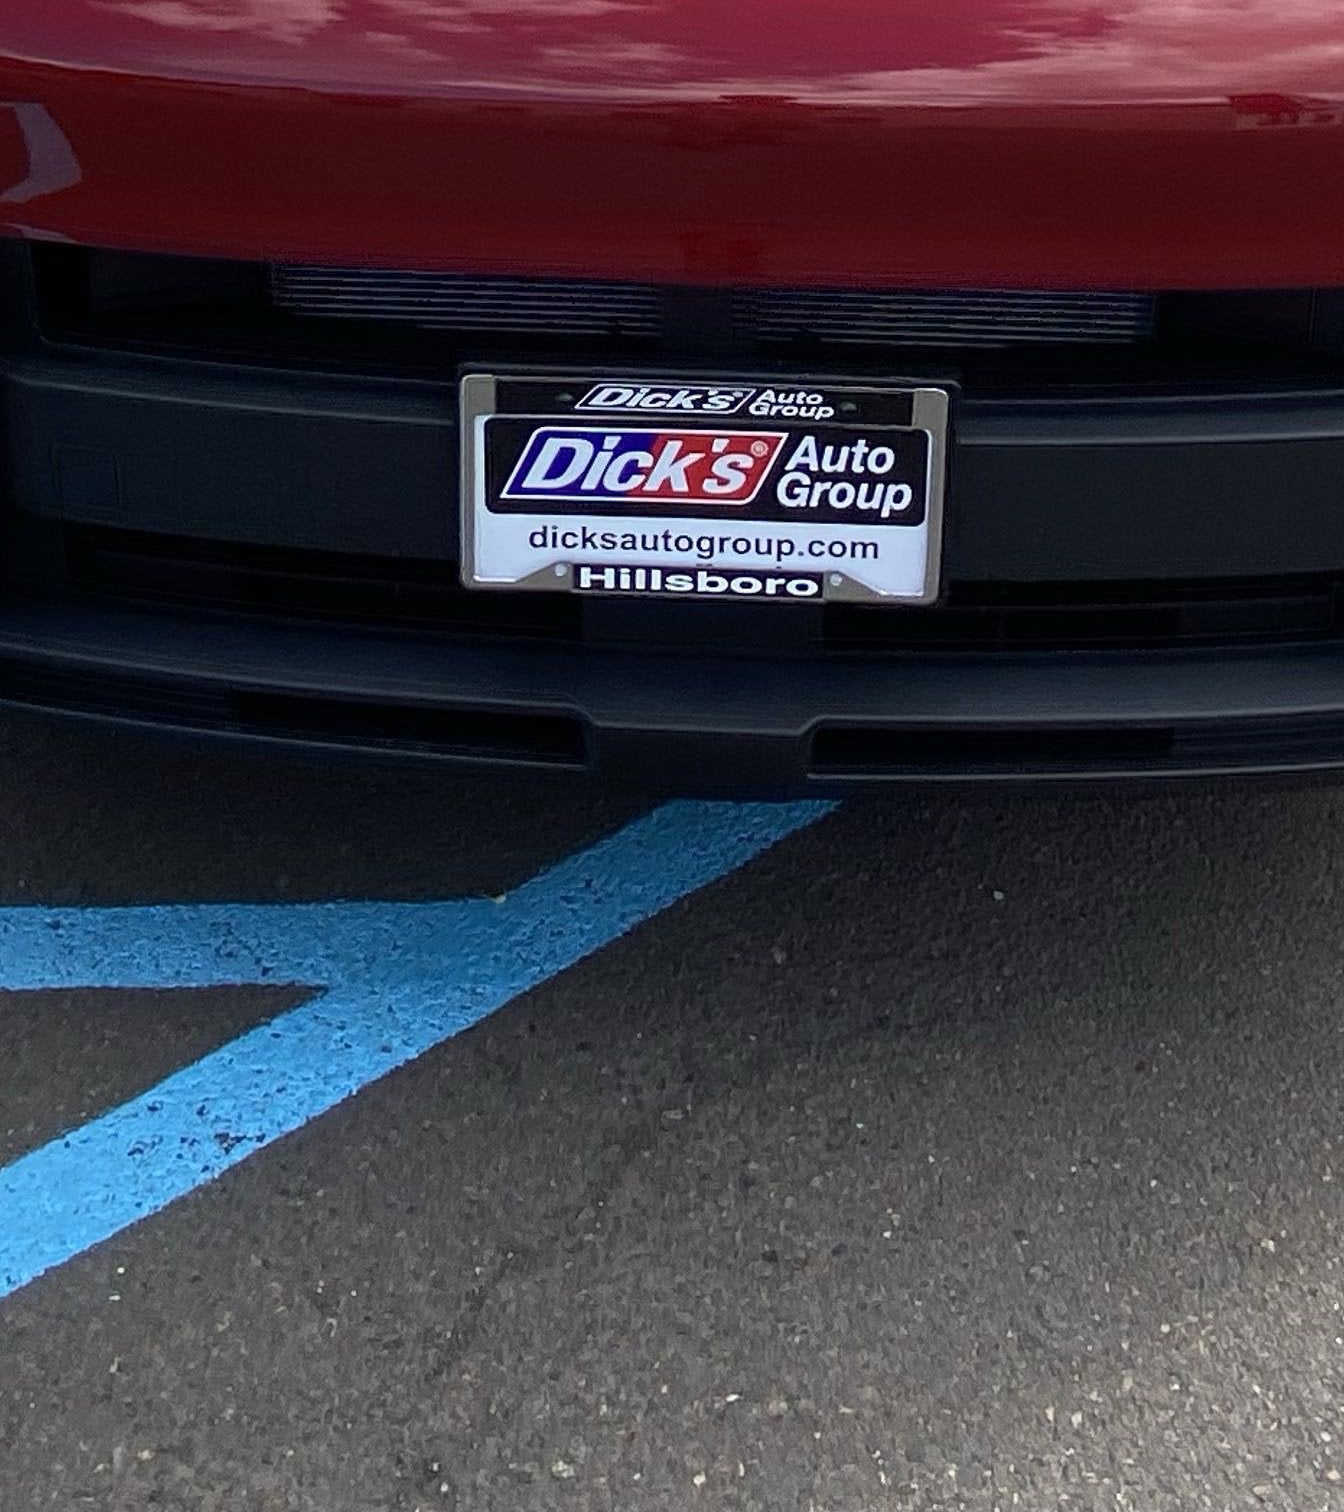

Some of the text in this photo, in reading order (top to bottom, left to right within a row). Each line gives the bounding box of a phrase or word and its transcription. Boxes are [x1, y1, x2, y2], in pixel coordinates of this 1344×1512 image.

[748, 403, 836, 421] Group
[755, 389, 824, 406] Auto
[520, 434, 755, 496] Dick's
[783, 434, 896, 476] Auto
[775, 472, 913, 519] Group
[528, 524, 880, 562] dicksautogroup.com
[579, 566, 819, 597] Hillsboro
